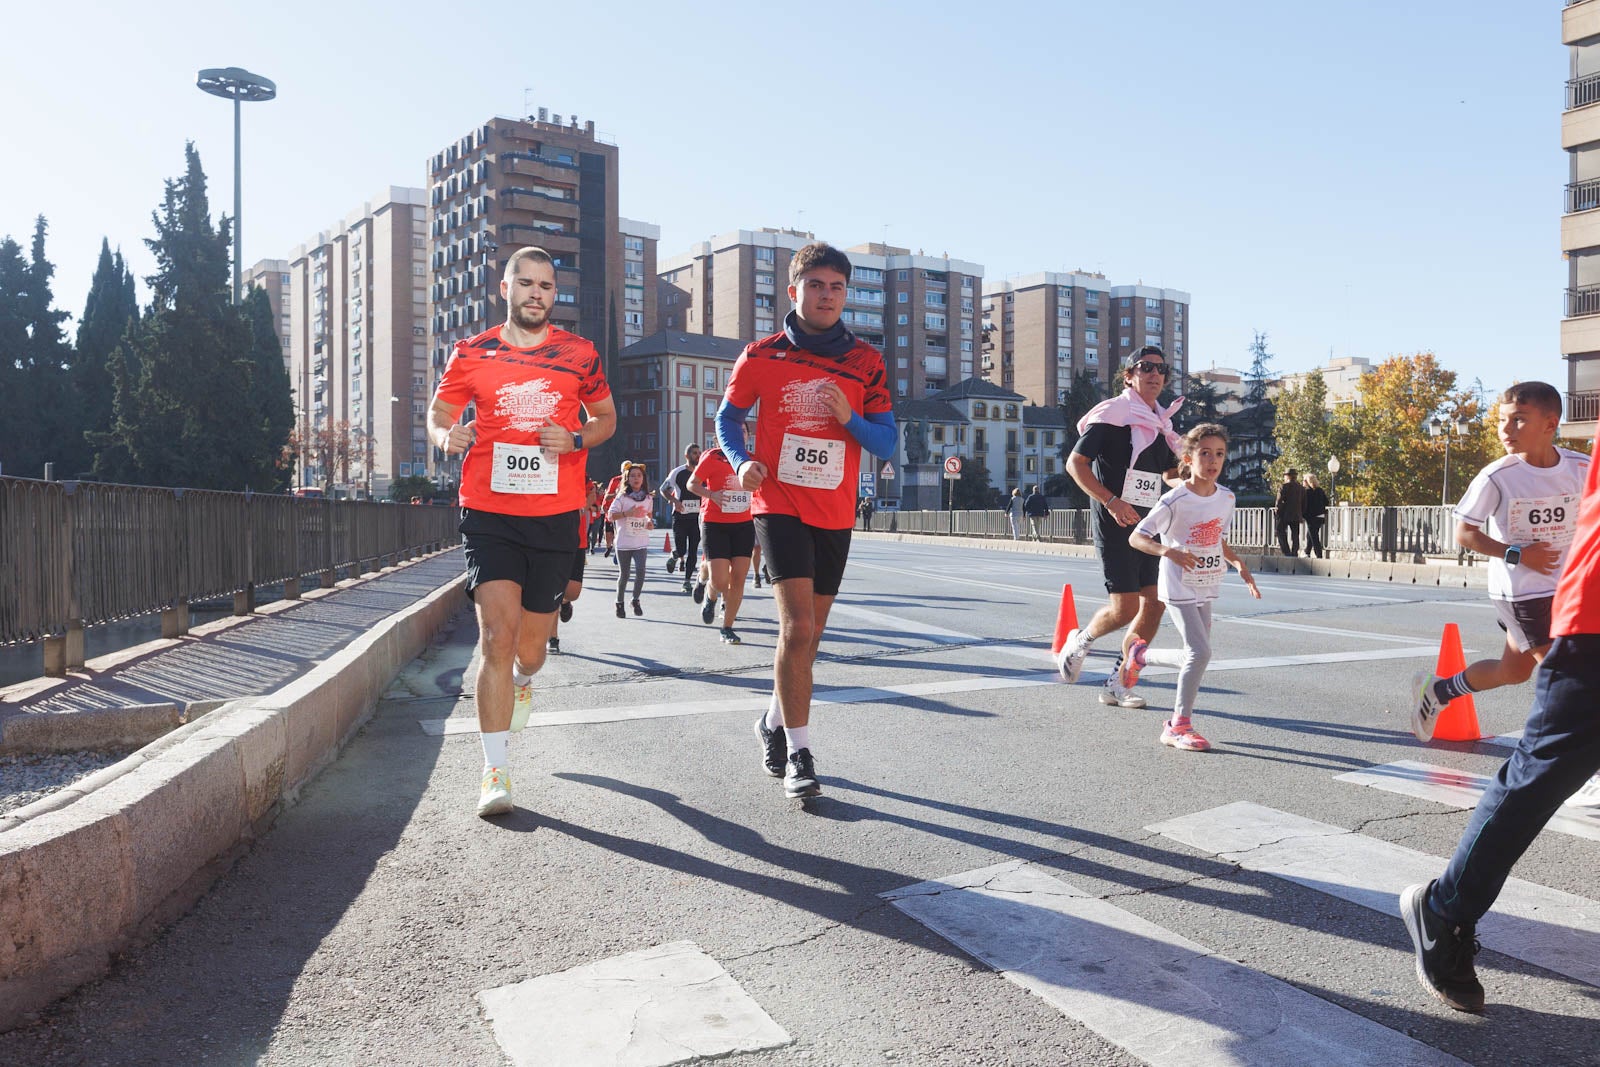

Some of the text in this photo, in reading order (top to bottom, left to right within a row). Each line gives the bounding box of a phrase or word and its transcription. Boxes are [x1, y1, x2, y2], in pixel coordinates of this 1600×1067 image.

[499, 394, 556, 406] carrera
[783, 393, 830, 403] carre
[507, 455, 540, 471] 906
[795, 447, 828, 465] 856
[1135, 478, 1156, 491] 394
[1528, 507, 1565, 525] 639
[1197, 555, 1221, 569] 395
